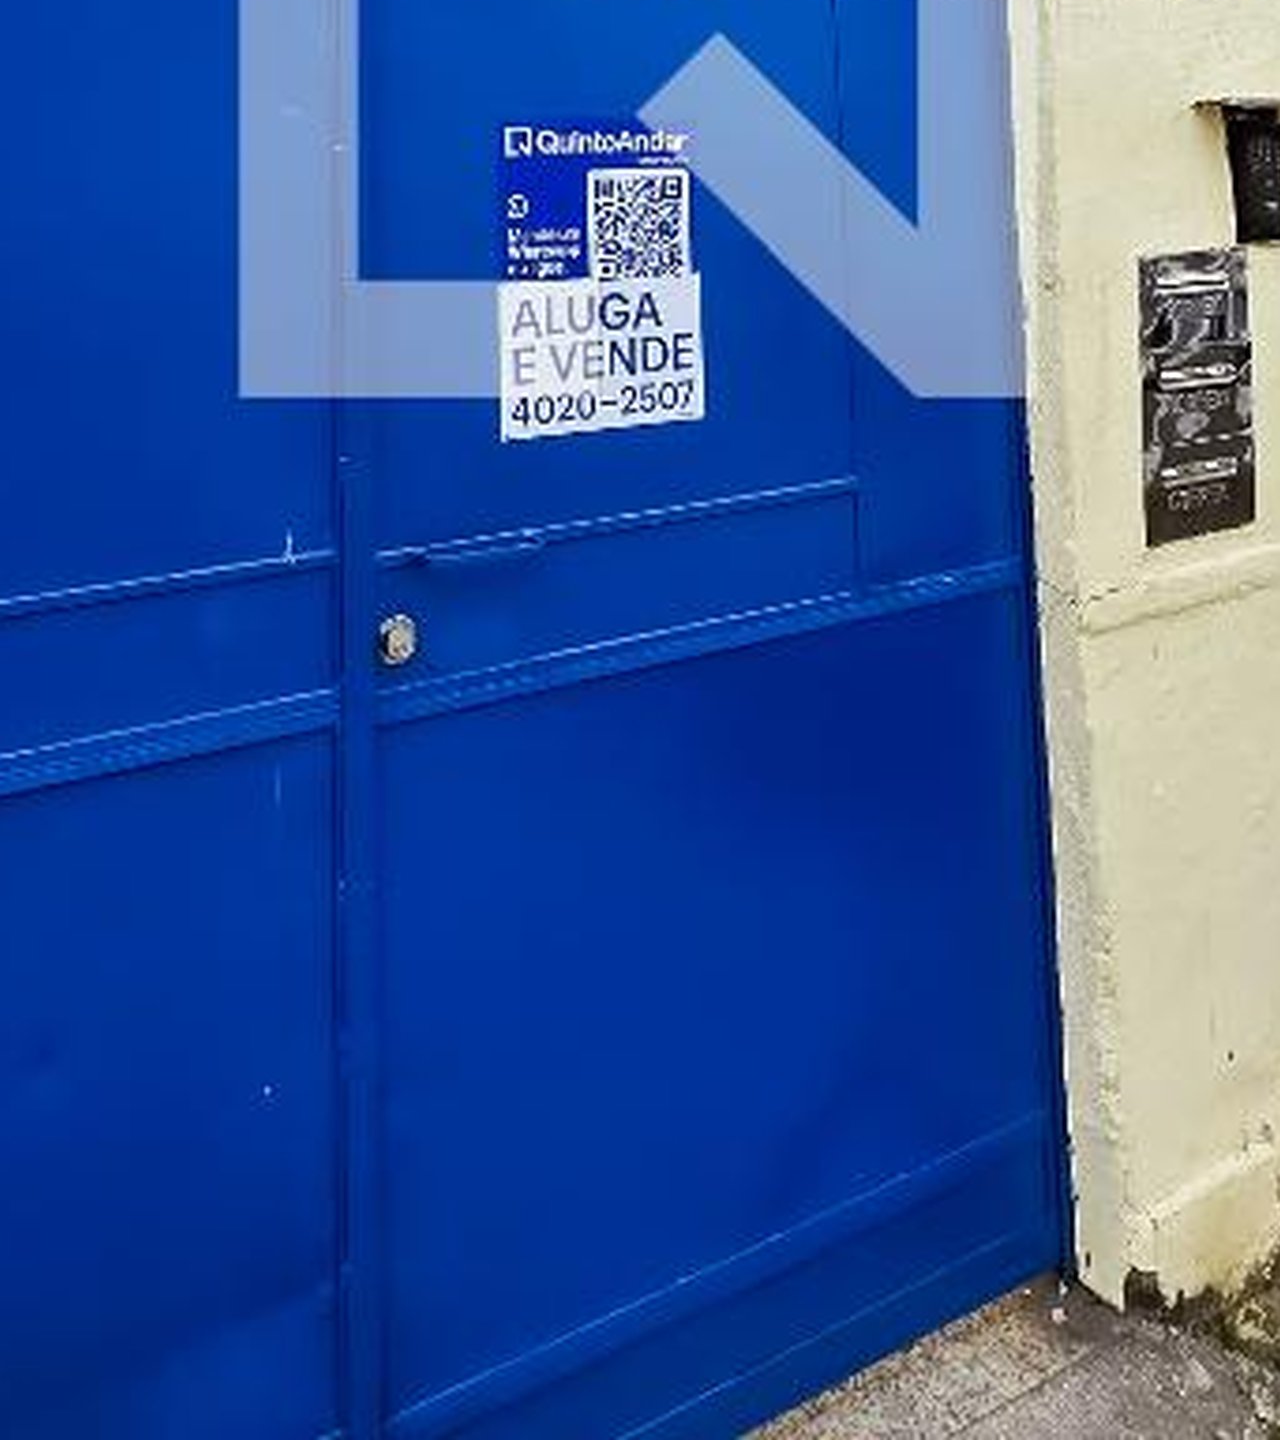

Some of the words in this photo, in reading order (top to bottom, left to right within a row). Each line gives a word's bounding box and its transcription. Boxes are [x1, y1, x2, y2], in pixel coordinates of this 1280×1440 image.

[511, 292, 663, 338] ALUGA
[513, 346, 536, 385] E
[549, 333, 694, 383] VENDE
[511, 379, 695, 427] 4020-2507
